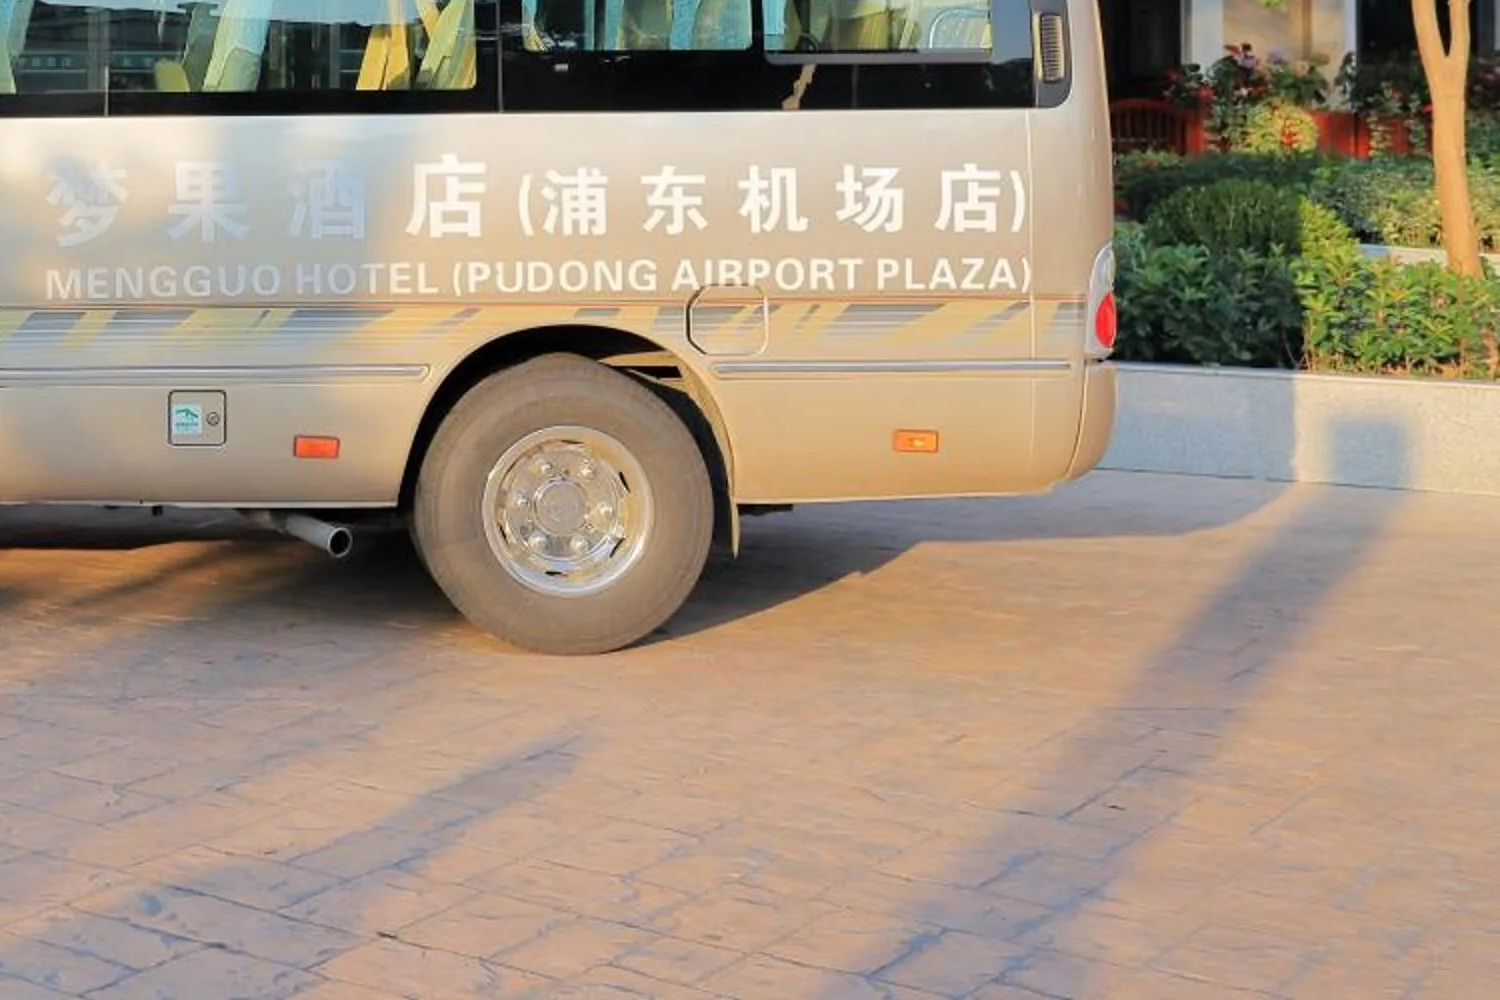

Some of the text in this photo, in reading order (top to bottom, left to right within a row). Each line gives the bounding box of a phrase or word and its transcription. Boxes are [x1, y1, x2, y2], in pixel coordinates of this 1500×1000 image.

[46, 257, 1032, 300] MENGGUO HOTEL (PUDONG AIRPORT PLAZA)
